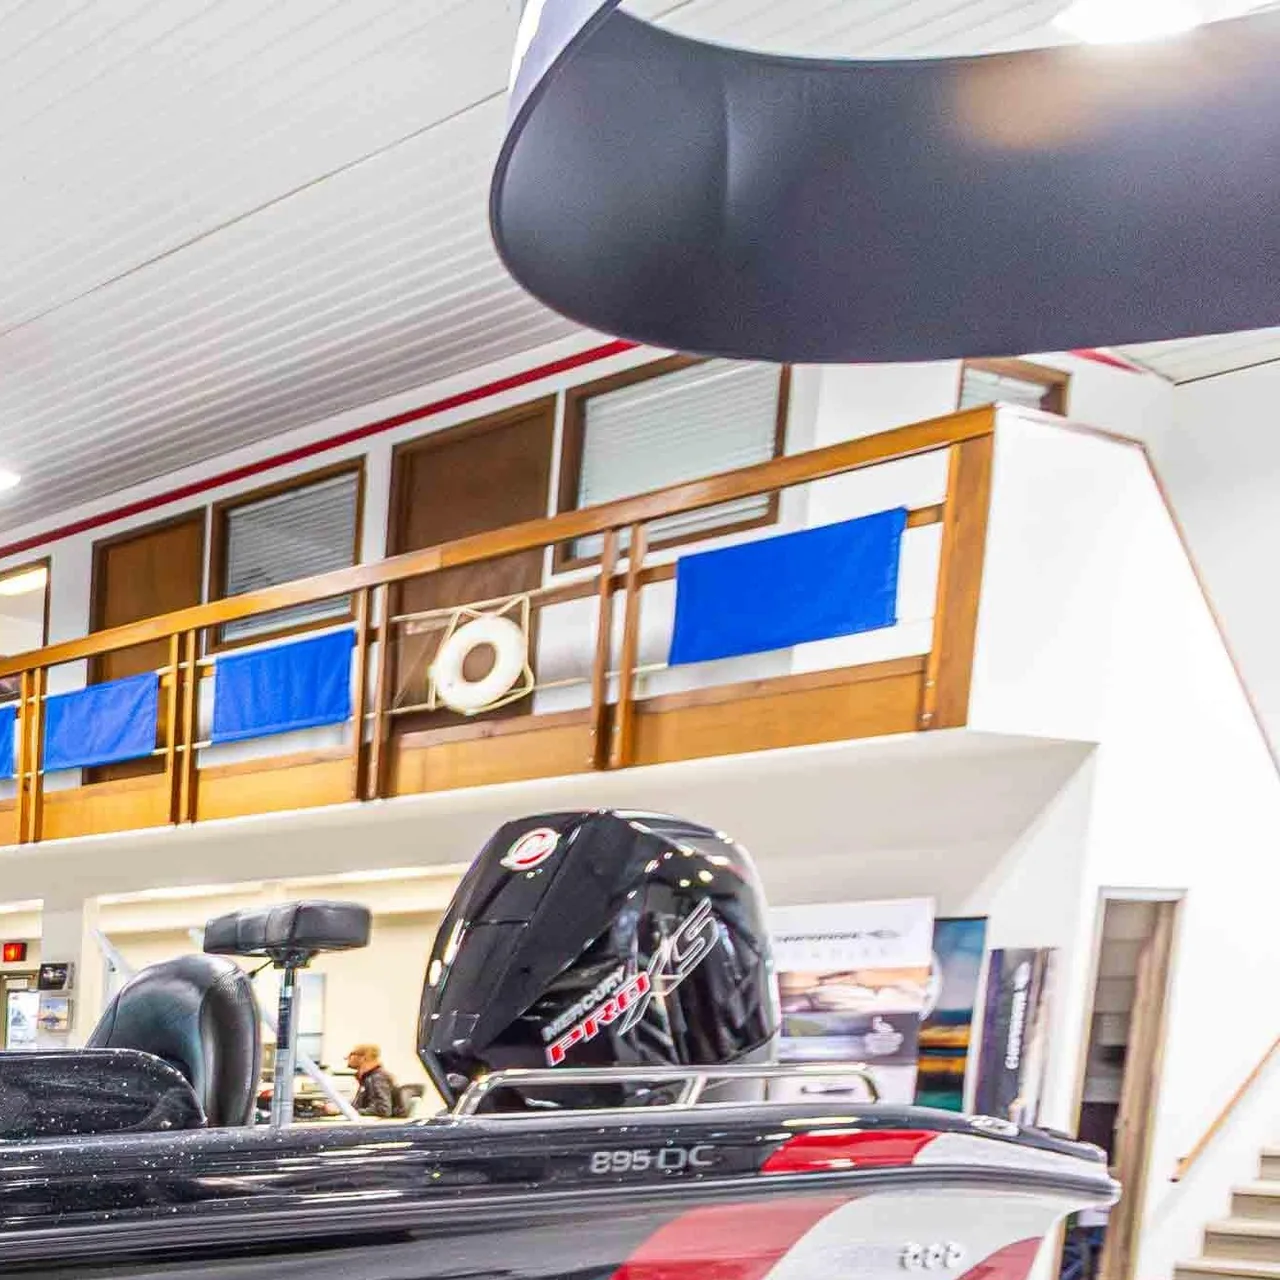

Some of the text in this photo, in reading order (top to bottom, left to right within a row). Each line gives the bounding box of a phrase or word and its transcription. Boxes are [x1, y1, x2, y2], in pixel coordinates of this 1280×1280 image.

[542, 965, 626, 1041] MERCURY
[545, 971, 651, 1067] PRO
[589, 1145, 715, 1174] 895 DC
